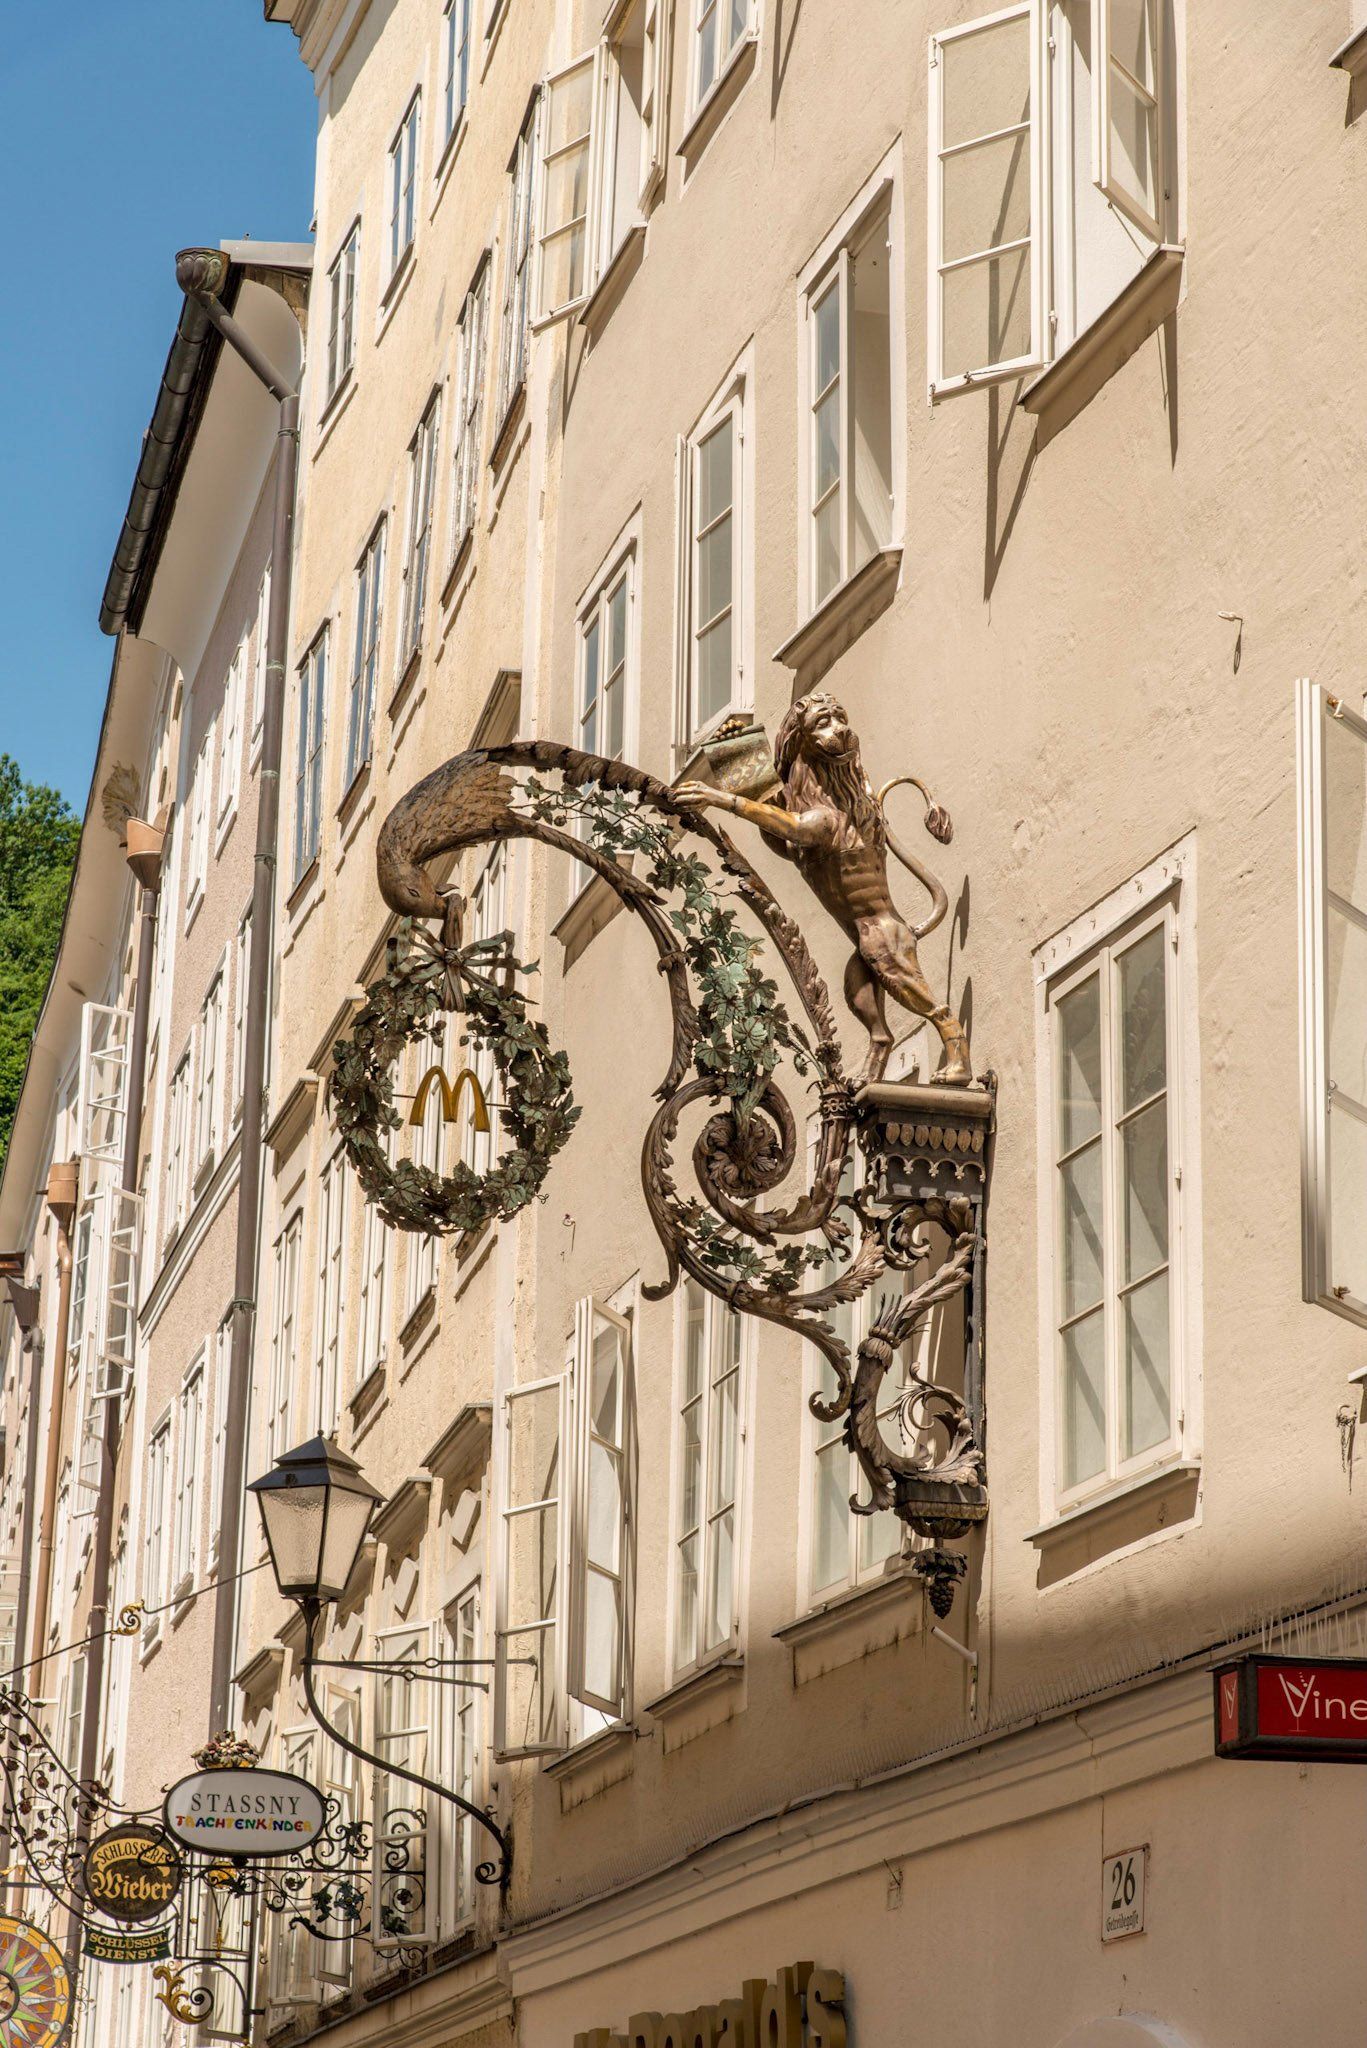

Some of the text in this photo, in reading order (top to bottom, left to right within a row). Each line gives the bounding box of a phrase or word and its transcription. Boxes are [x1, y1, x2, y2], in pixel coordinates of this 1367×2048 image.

[191, 1793, 301, 1815] STASSNY
[175, 1815, 313, 1833] TRACHTENKINDER
[91, 1868, 173, 1900] Wieber
[1111, 1857, 1136, 1910] 26
[93, 1946, 159, 1960] DIENST
